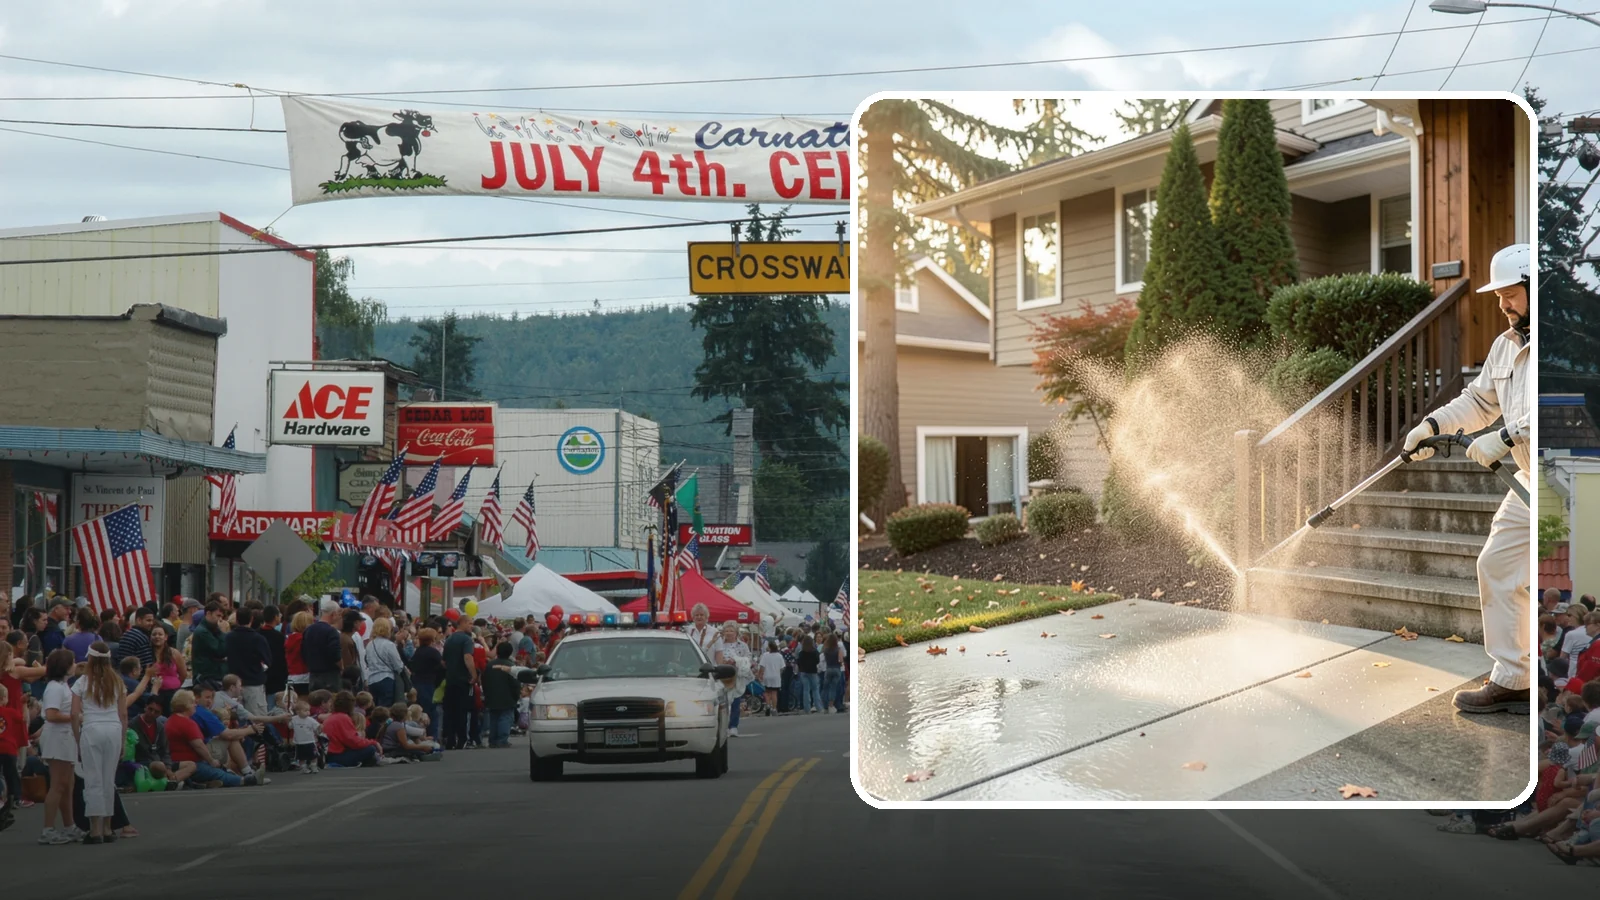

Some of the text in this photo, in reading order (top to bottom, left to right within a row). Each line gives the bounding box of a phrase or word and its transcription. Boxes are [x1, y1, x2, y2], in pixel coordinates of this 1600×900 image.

[694, 121, 850, 150] Carnat
[481, 141, 604, 192] JULY
[632, 150, 746, 198] 4th.
[696, 254, 850, 280] CROSSWA
[282, 380, 374, 420] ACE
[405, 409, 485, 422] CEDAR LOG
[283, 421, 371, 437] Hardware
[416, 428, 477, 447] Coca-Cola
[353, 467, 384, 479] Simpl
[83, 485, 155, 495] St. Vincent de Paul
[688, 526, 741, 535] CRNATION
